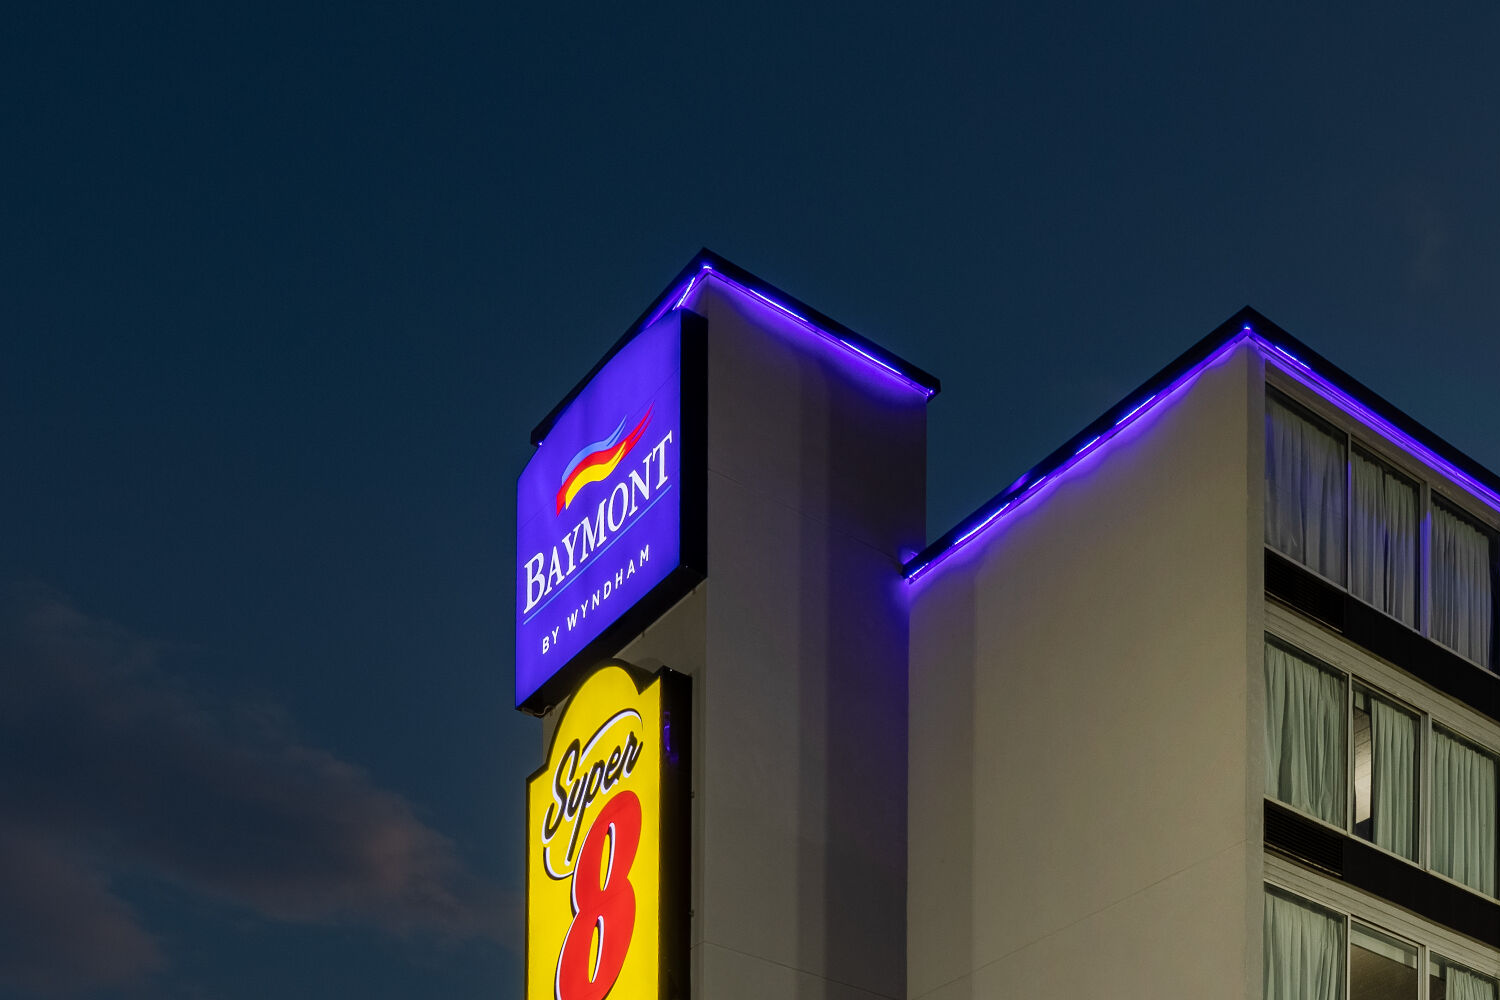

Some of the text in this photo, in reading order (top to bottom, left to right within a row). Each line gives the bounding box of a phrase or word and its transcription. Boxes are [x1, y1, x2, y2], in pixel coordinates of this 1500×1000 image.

[523, 430, 672, 613] BAYMONT
[542, 544, 649, 654] BY WYNDHAM
[542, 708, 643, 868] Super
